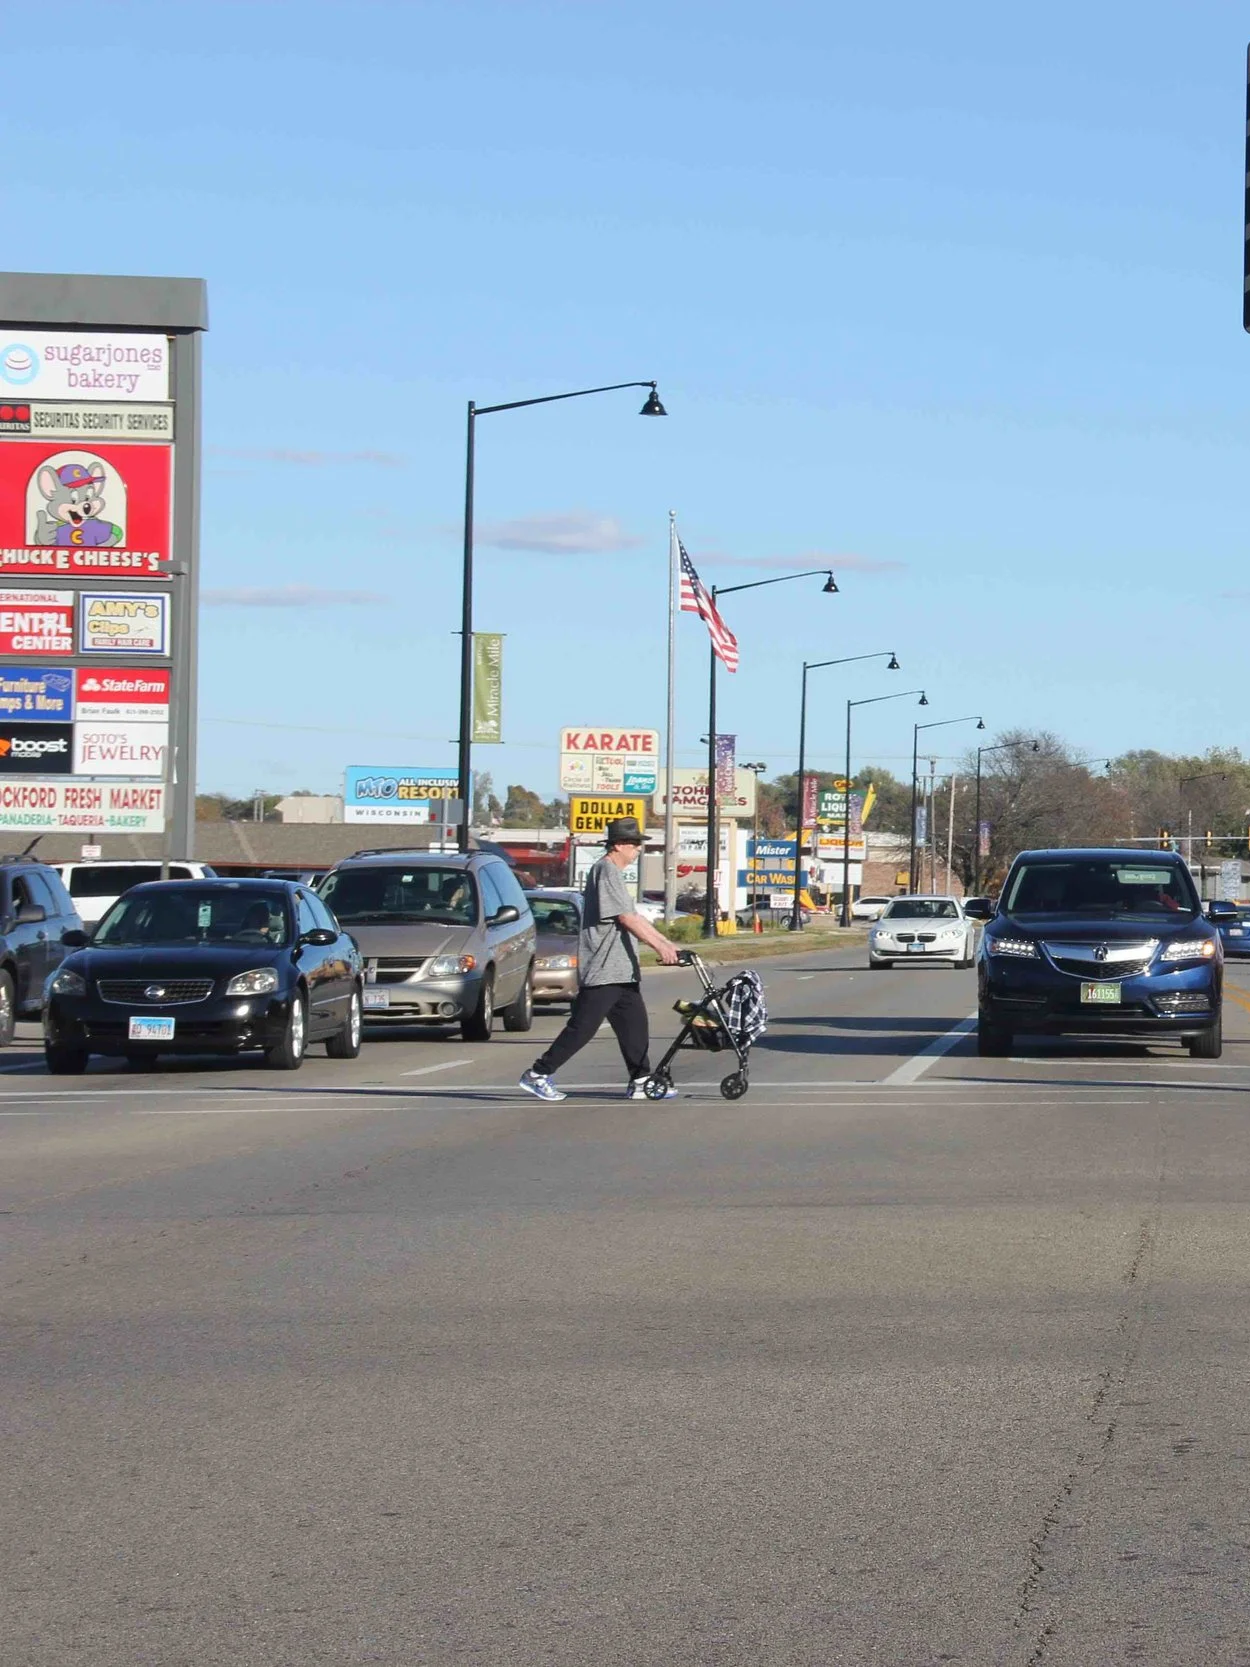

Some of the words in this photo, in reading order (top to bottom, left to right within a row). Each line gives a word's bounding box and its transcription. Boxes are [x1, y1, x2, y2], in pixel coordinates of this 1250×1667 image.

[44, 344, 163, 367] sugarjones
[67, 368, 140, 393] bakery
[34, 411, 80, 429] SECURITAS
[82, 412, 124, 430] SECURITY
[127, 413, 169, 431] SERVICES
[55, 549, 69, 569] E
[73, 550, 160, 572] CHEESE'S
[11, 635, 72, 651] CENTER
[486, 638, 500, 667] Mile
[486, 668, 500, 717] Miracle
[35, 694, 64, 711] More
[11, 737, 68, 753] boost
[565, 732, 653, 752] KARATE
[11, 751, 41, 759] mobile
[81, 745, 164, 764] JEWELRY
[399, 778, 415, 787] ALL
[418, 778, 460, 788] INCLUSIV
[63, 787, 103, 810] FRESH
[109, 788, 162, 811] MARKET
[355, 809, 422, 817] WISCONSIN
[580, 801, 635, 816] DOLLAR
[755, 844, 791, 856] Mister
[745, 872, 768, 884] CAR
[769, 872, 796, 884] WAS
